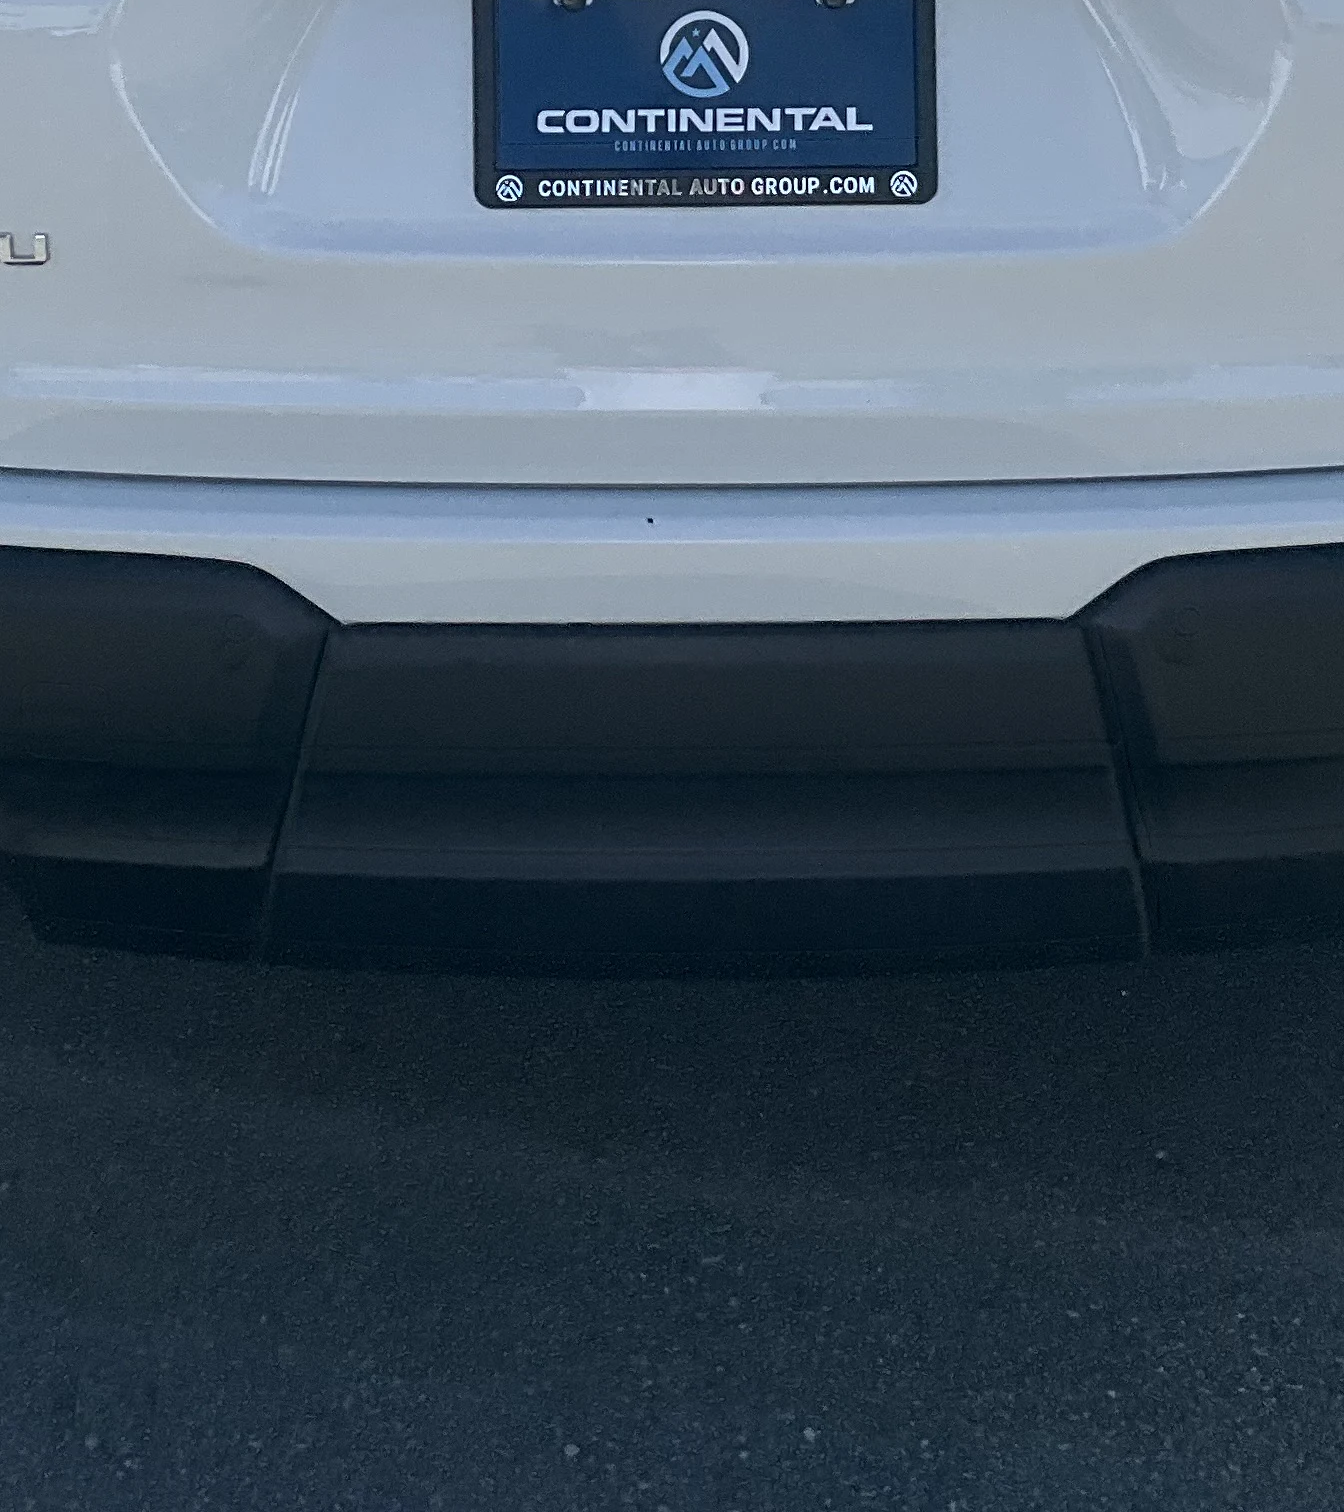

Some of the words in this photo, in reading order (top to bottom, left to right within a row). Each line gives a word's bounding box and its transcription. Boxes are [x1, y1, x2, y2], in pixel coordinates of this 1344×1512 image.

[536, 106, 874, 134] CONTINENTAL
[613, 139, 692, 152] CONTINENTAL
[695, 139, 726, 151] AUTO
[537, 178, 683, 197] CONTINENTAL
[689, 177, 745, 196] AUTO
